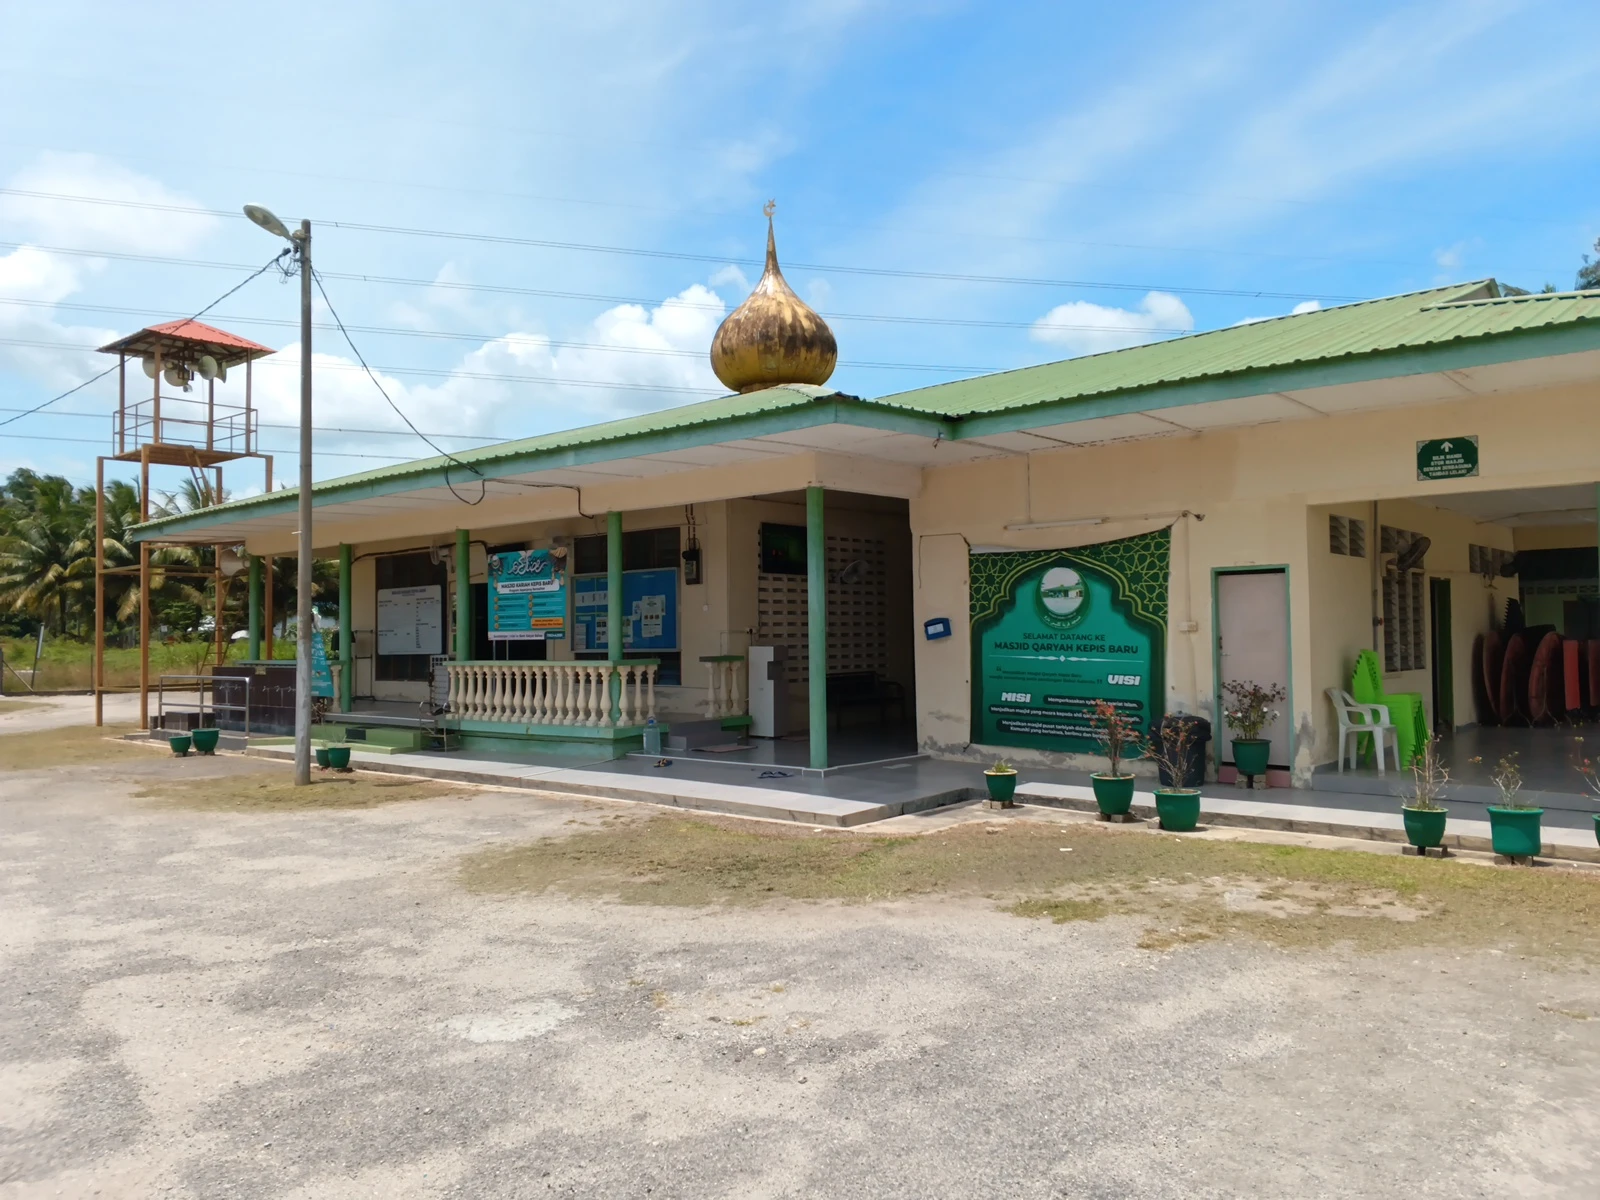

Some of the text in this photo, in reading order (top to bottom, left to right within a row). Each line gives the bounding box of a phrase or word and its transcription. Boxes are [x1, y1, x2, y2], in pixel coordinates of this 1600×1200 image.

[1023, 632, 1106, 642] SELAMAT DATANG KE
[994, 642, 1139, 654] MASJID QARYAH KEPIS BARU
[1001, 692, 1031, 703] MISI
